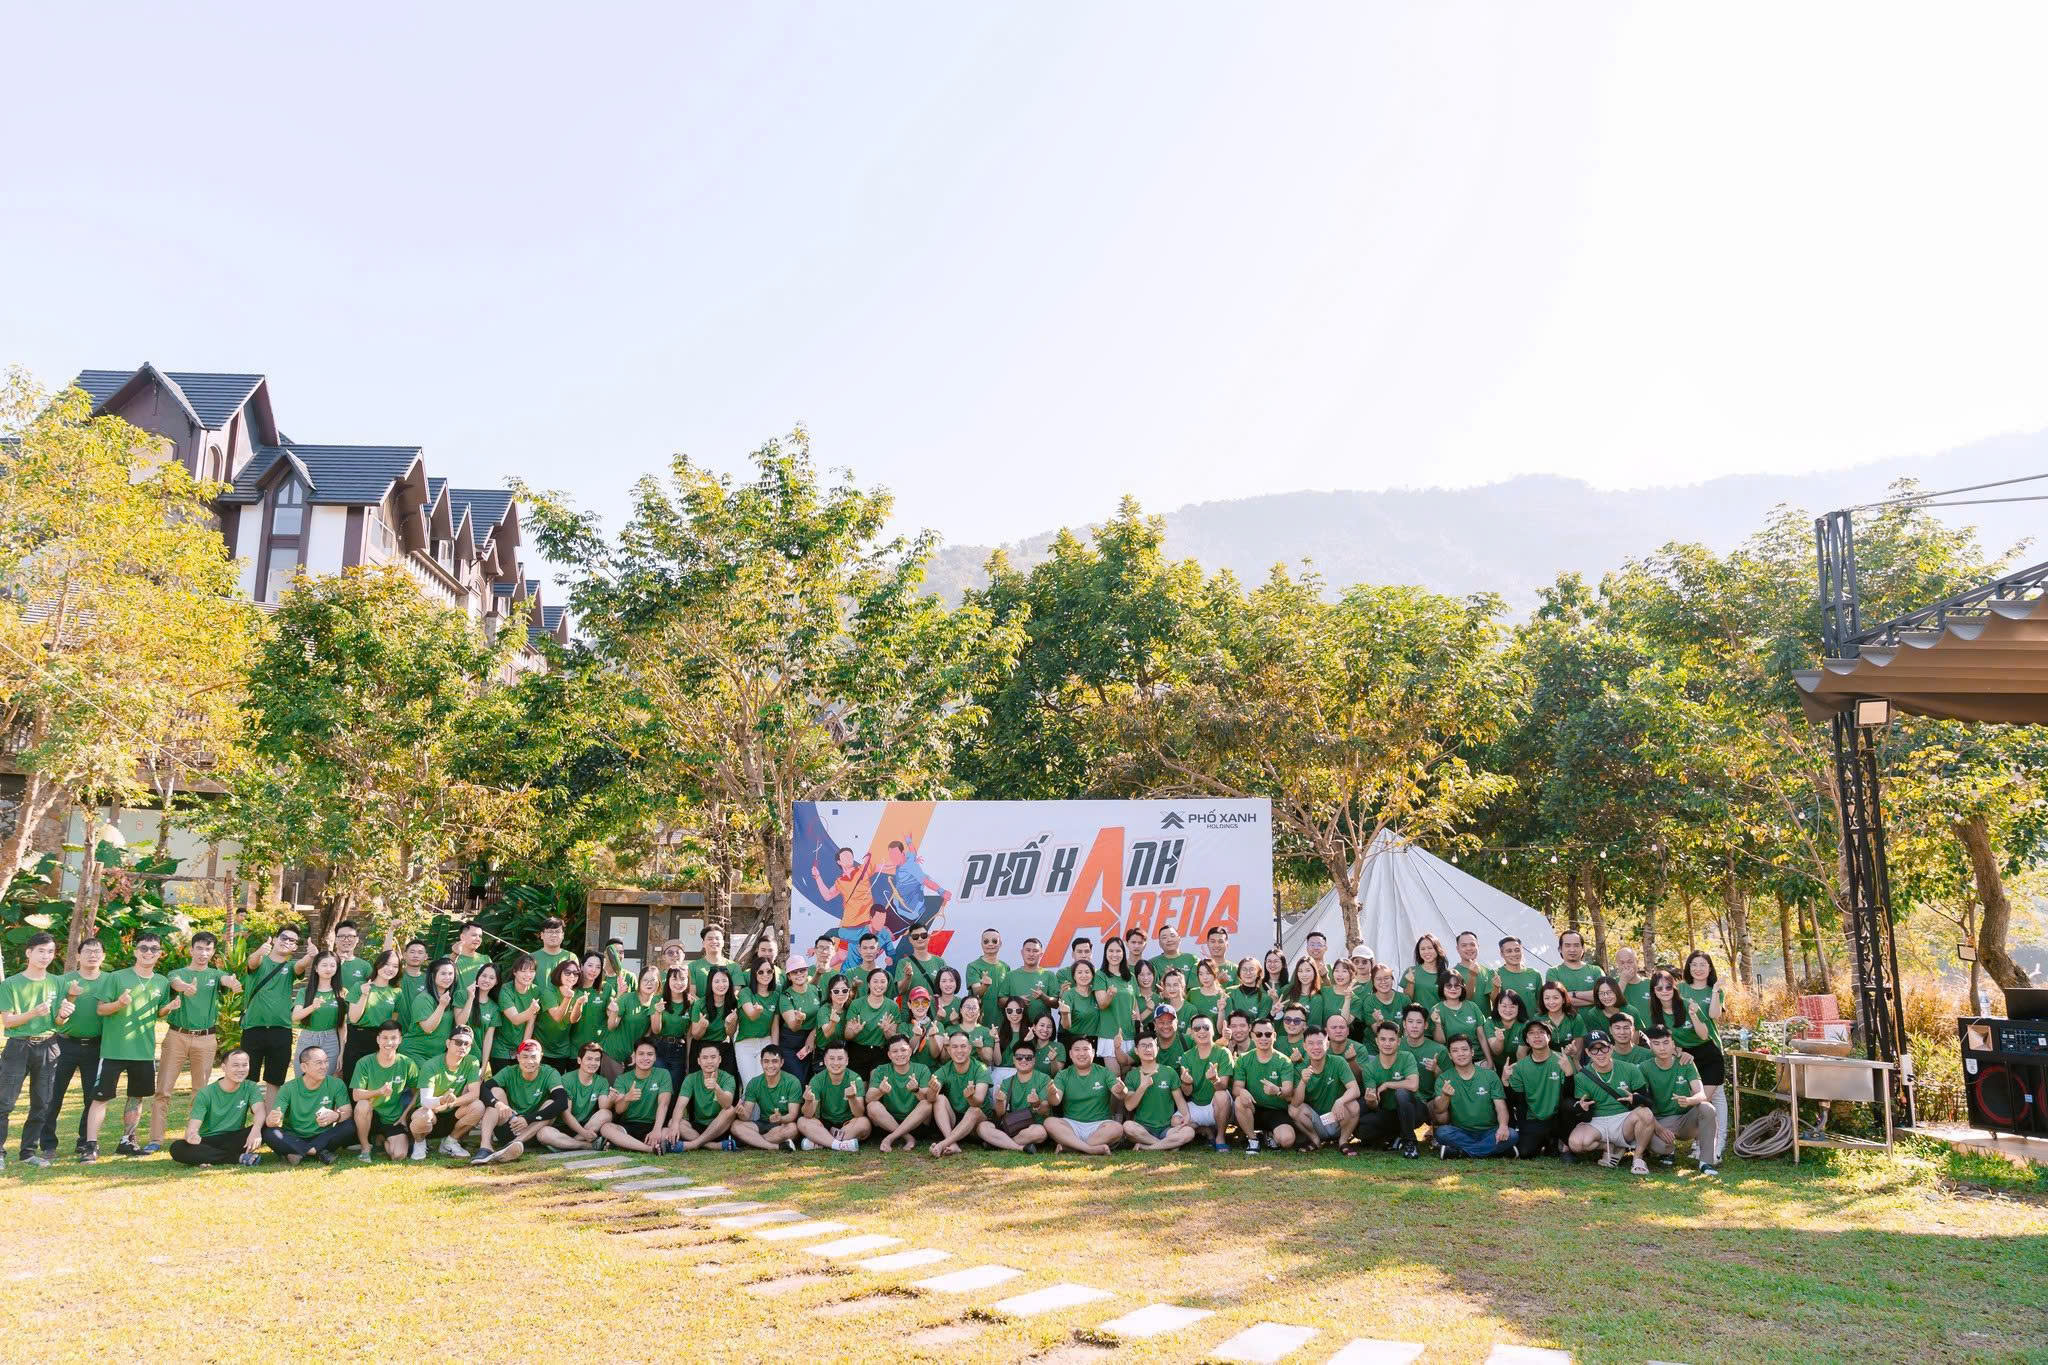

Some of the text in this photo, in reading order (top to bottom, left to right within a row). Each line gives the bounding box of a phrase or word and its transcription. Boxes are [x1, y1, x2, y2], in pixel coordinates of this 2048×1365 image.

[1188, 809, 1256, 823] PHỐ XANH
[960, 835, 1049, 899] PHỐ
